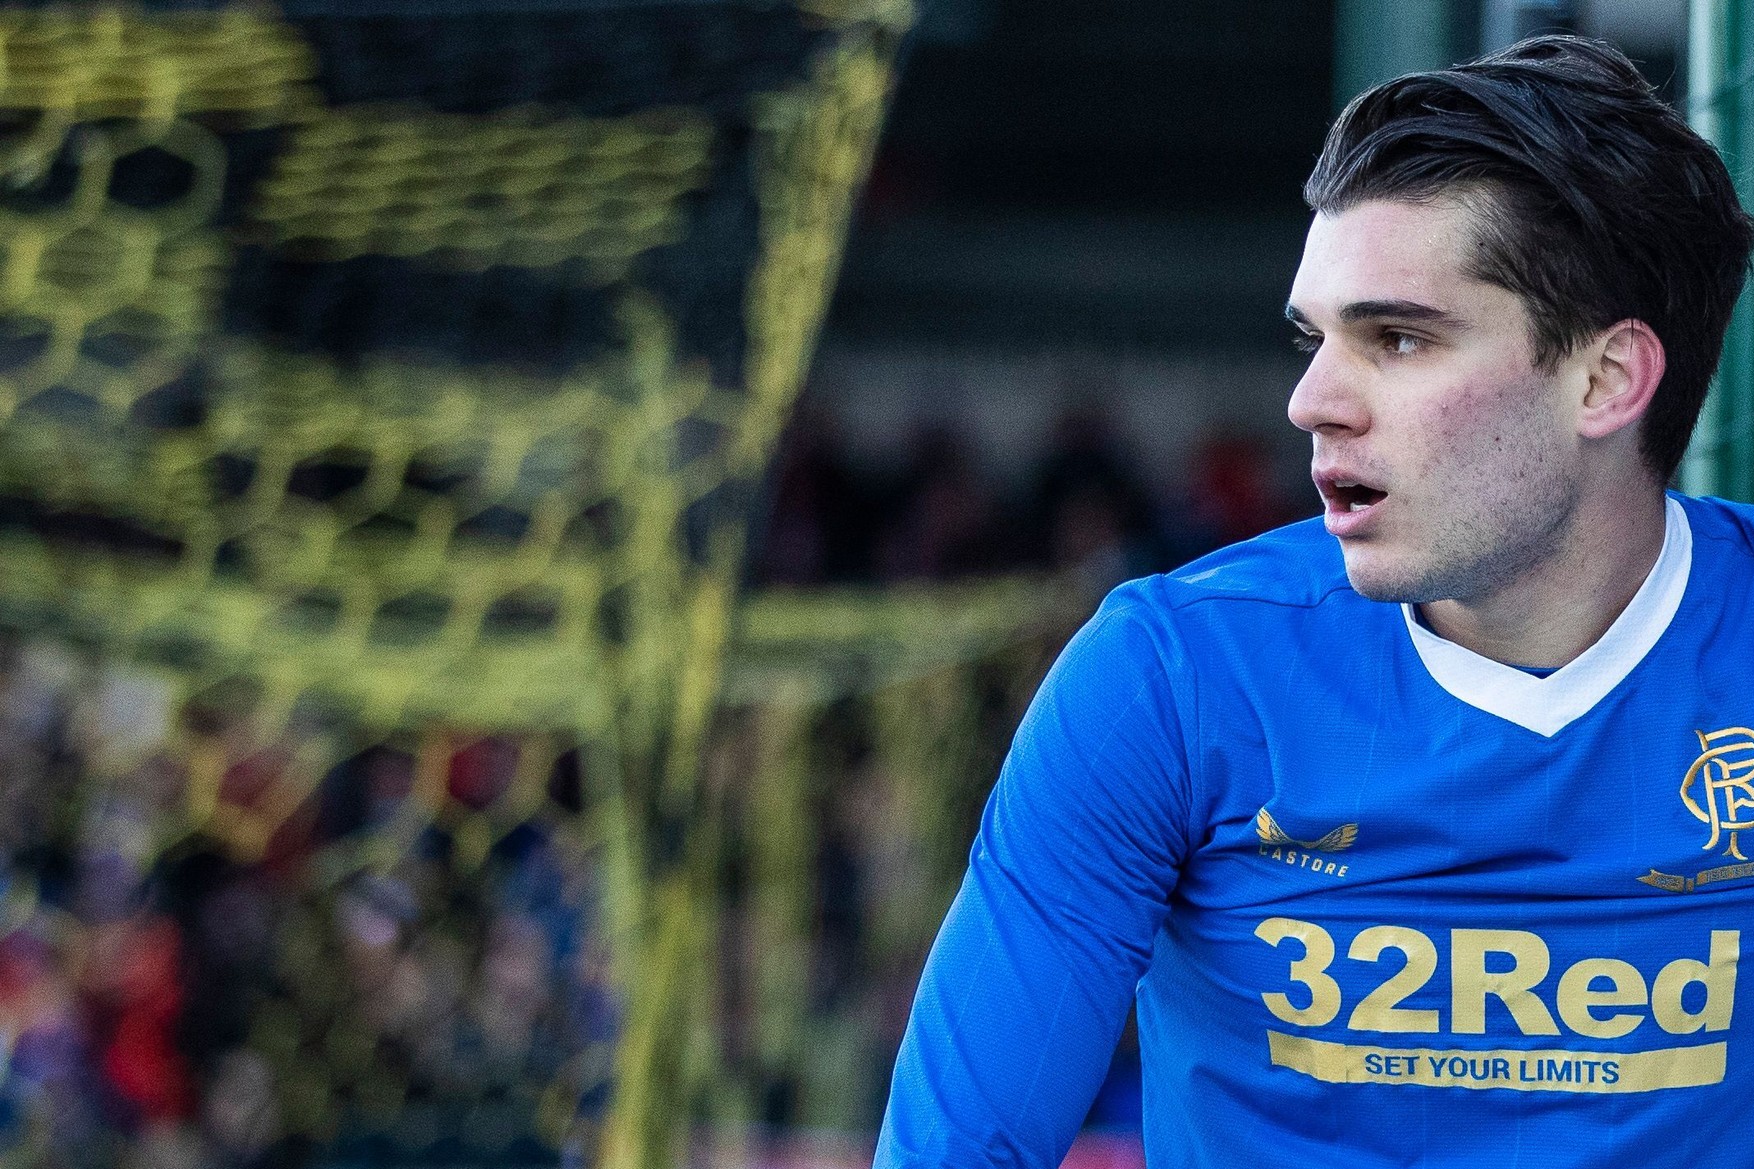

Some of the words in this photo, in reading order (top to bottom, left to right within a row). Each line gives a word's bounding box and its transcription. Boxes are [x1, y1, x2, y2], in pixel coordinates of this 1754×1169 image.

[1253, 917, 1741, 1039] 32Red
[1364, 1053, 1419, 1076] SET
[1428, 1056, 1510, 1080] YOUR
[1519, 1059, 1620, 1084] LIMITS
